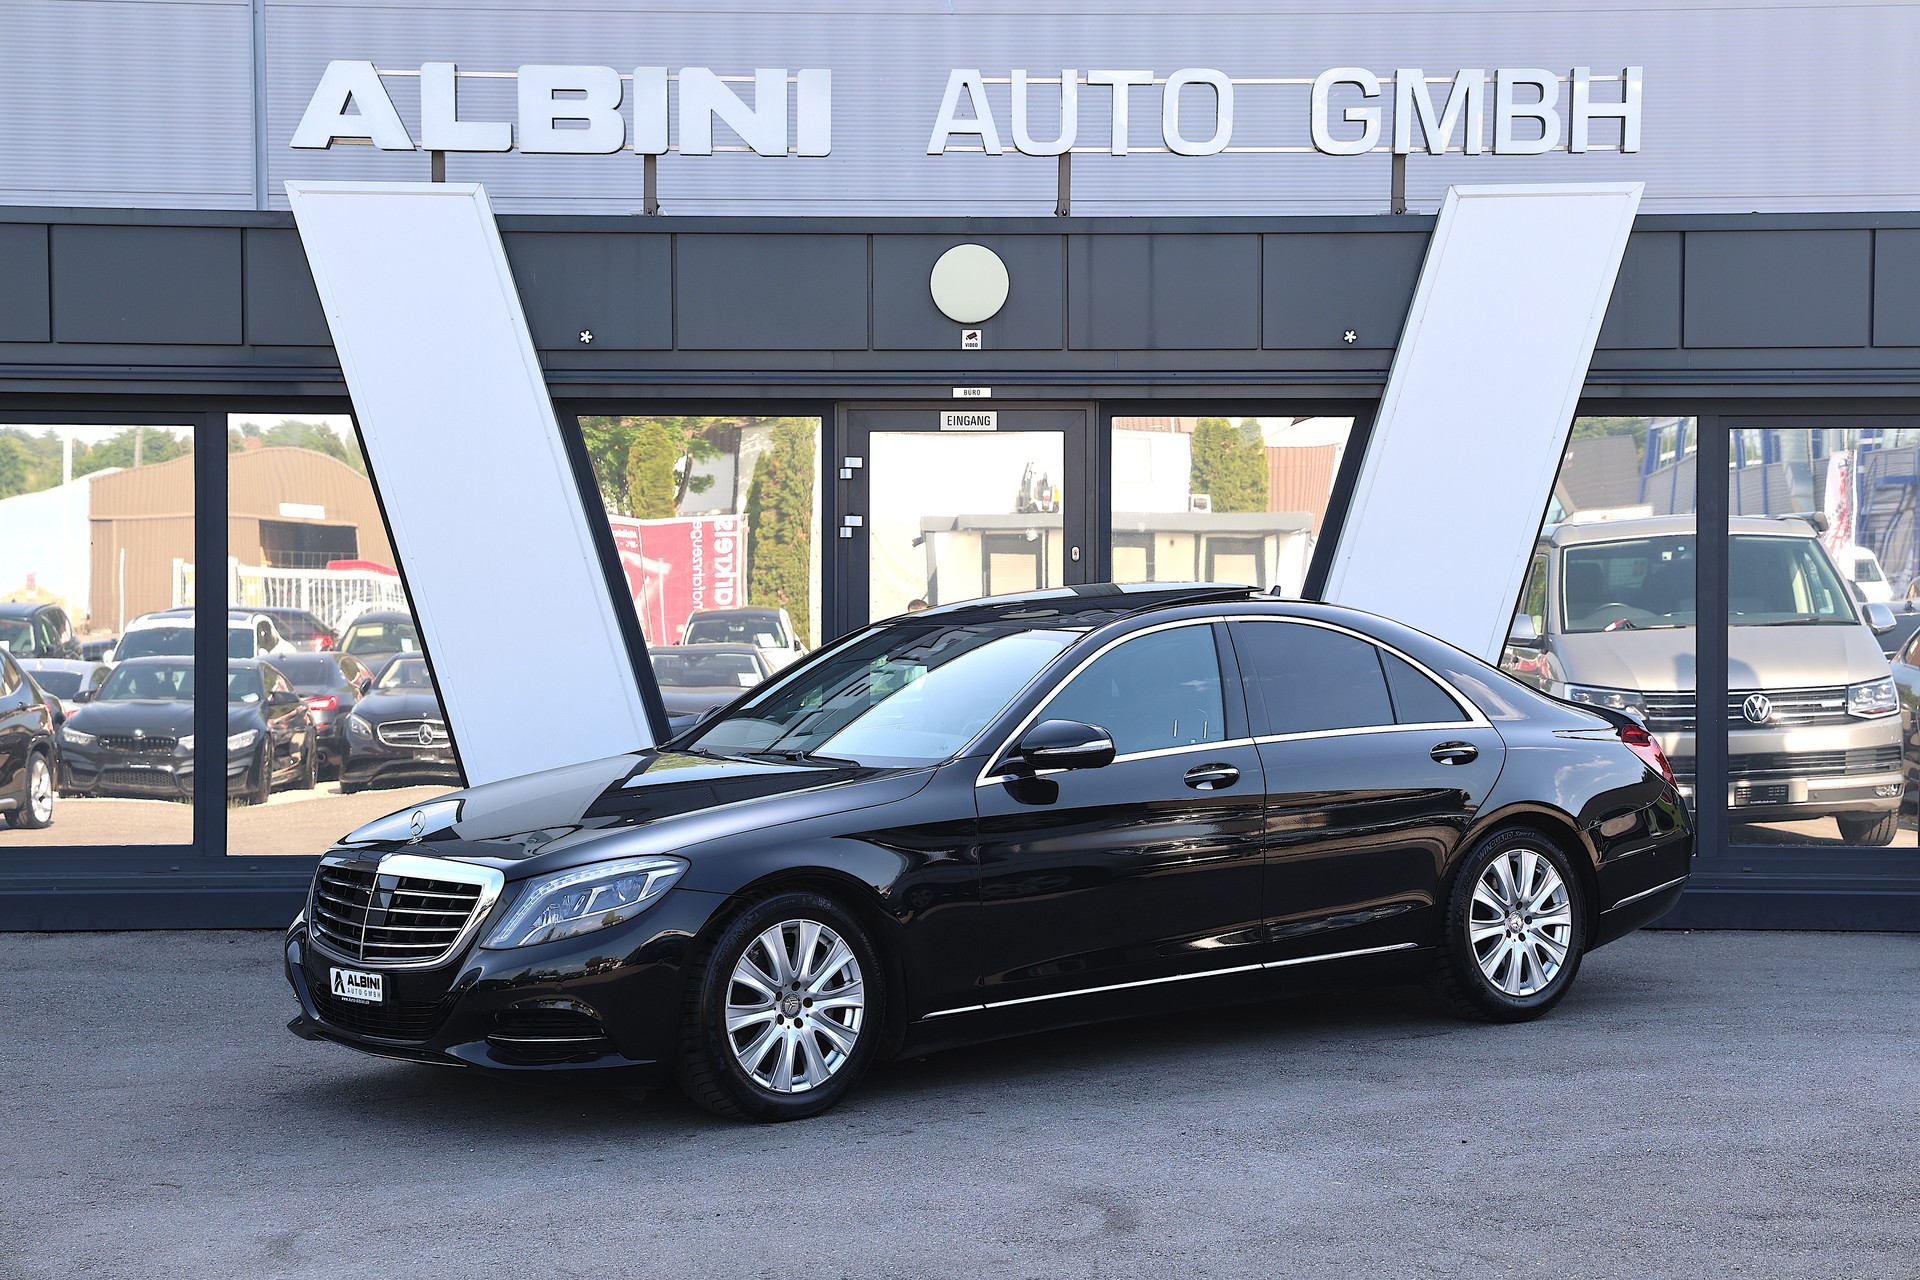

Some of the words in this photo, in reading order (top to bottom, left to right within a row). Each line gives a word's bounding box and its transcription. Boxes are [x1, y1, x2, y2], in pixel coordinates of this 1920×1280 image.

[290, 60, 832, 157] ALBINI
[926, 67, 1235, 157] AUTO
[1310, 65, 1644, 156] GMBH
[947, 415, 991, 426] EINGANG
[347, 974, 381, 990] ALBINI
[347, 987, 362, 995] AUTO
